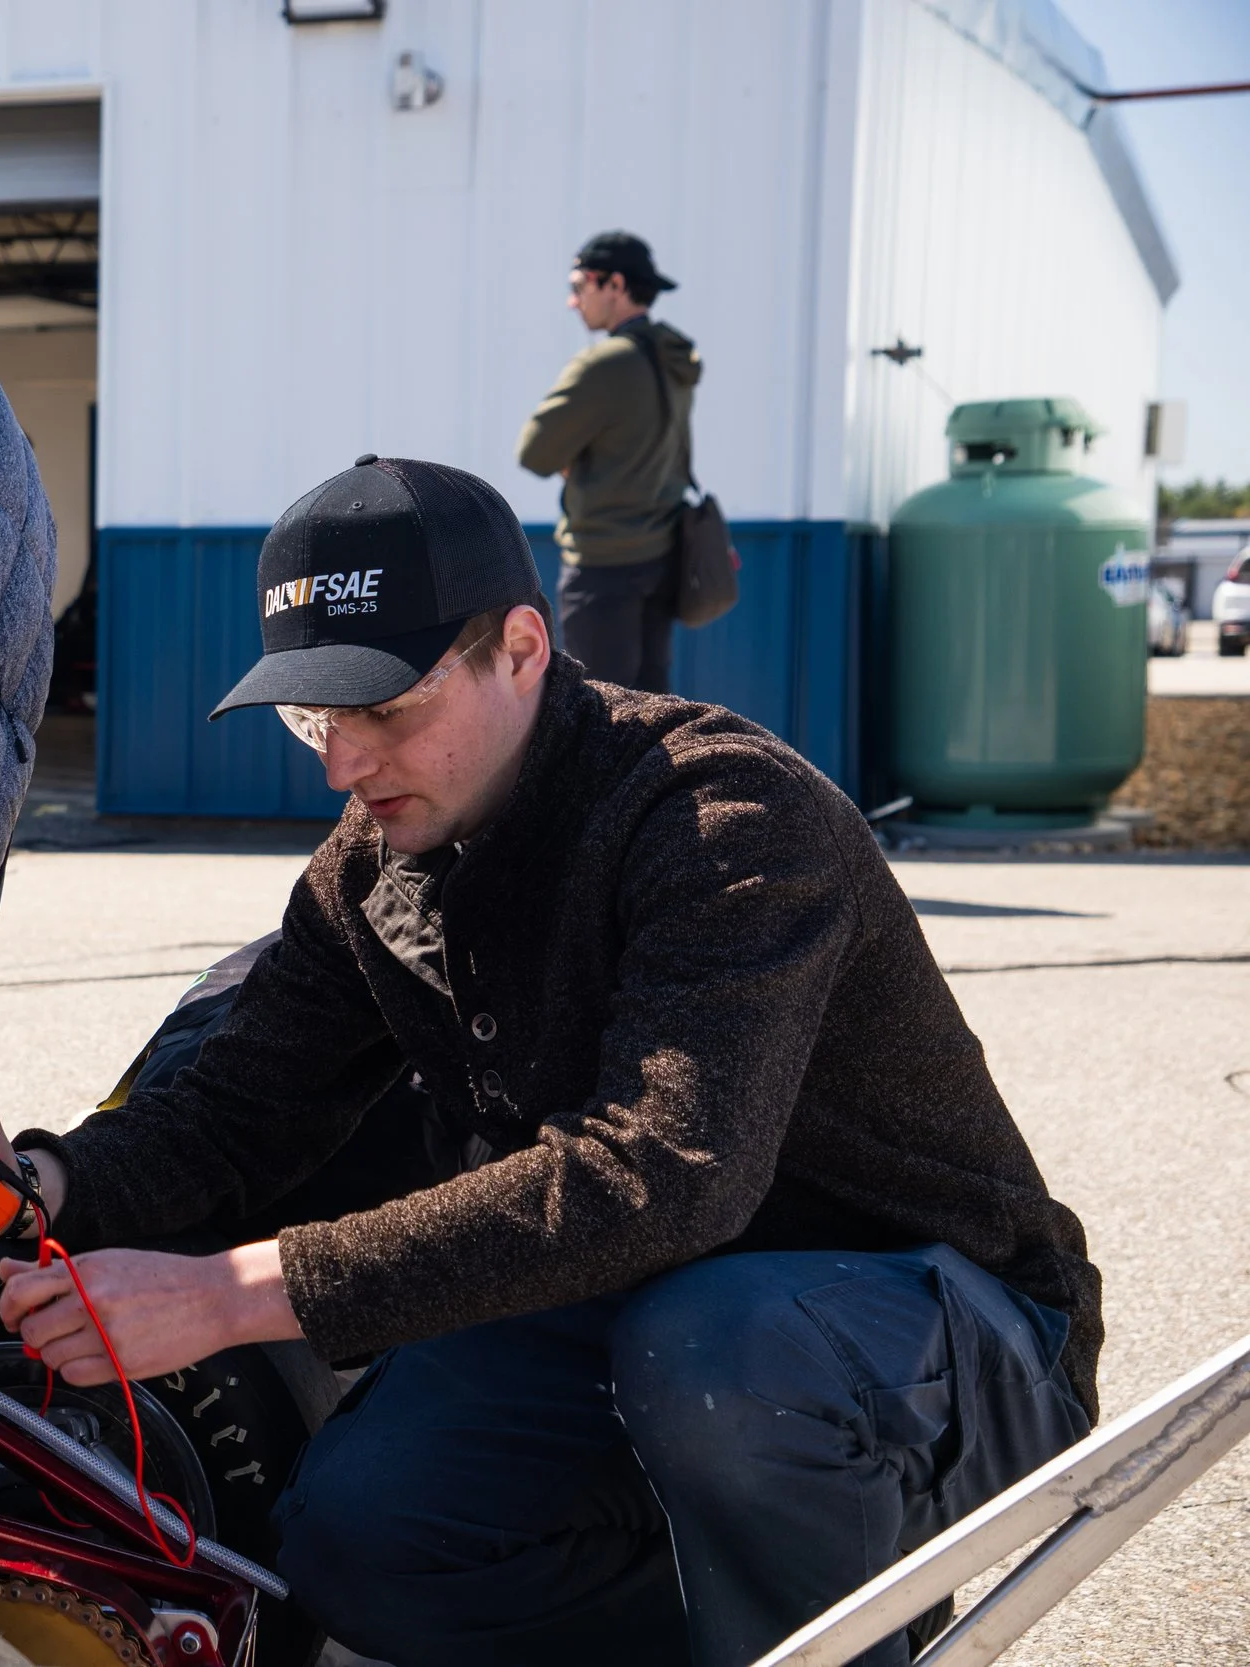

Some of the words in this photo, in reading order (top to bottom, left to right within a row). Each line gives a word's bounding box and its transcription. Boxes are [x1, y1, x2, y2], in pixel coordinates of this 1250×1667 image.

[265, 583, 289, 618] DAL
[309, 569, 383, 603] FSAE
[327, 601, 378, 616] DMS-25
